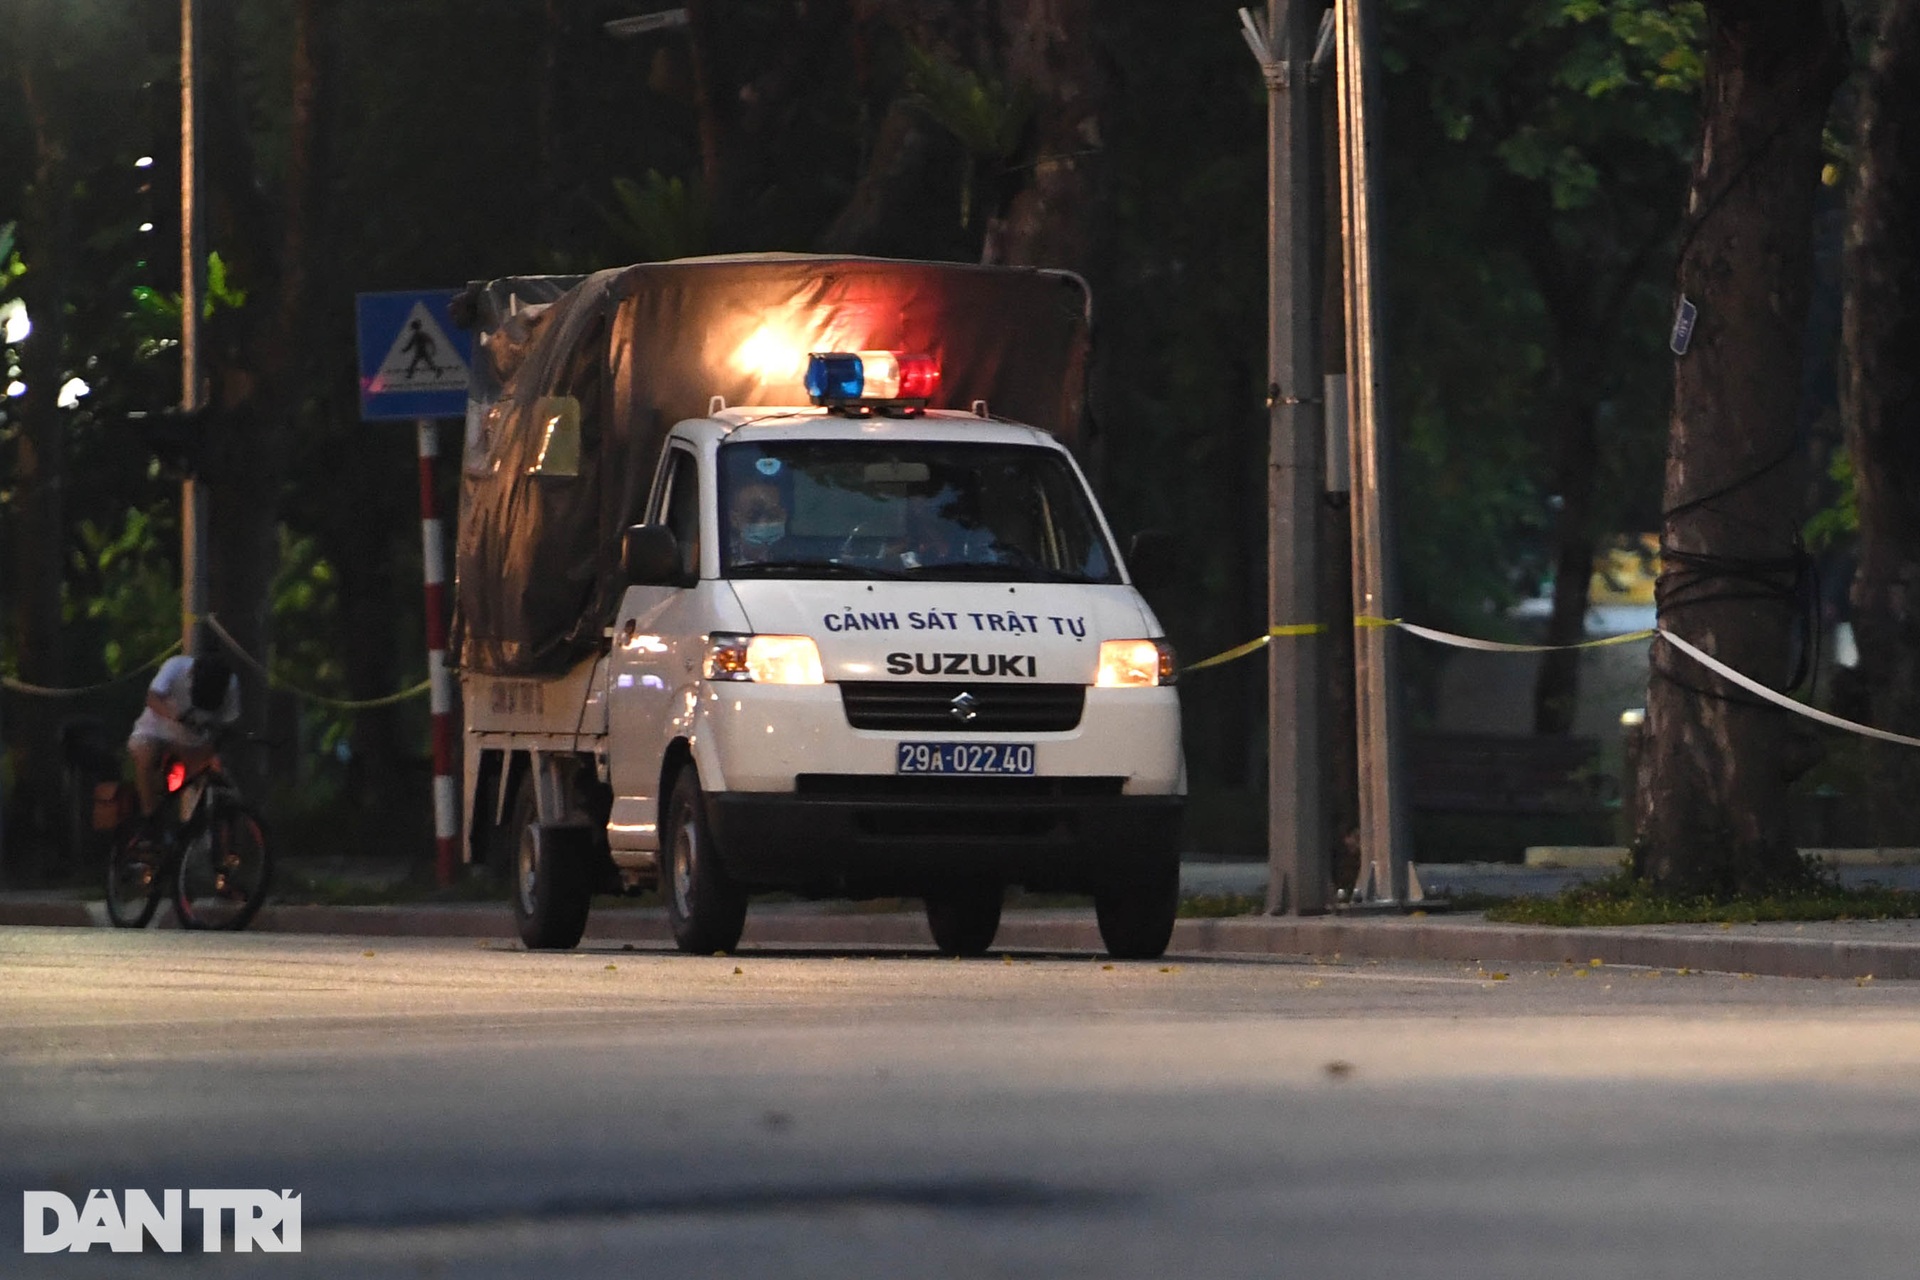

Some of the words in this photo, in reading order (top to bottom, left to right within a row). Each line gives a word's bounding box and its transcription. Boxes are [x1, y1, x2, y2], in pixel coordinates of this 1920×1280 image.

[823, 606, 899, 632] CẢNH
[908, 608, 957, 630] SÁT
[968, 612, 1037, 636] TRẬT
[1049, 616, 1086, 642] TỰ
[886, 652, 1037, 678] SUZUKI
[900, 744, 1032, 773] 29A-022.40
